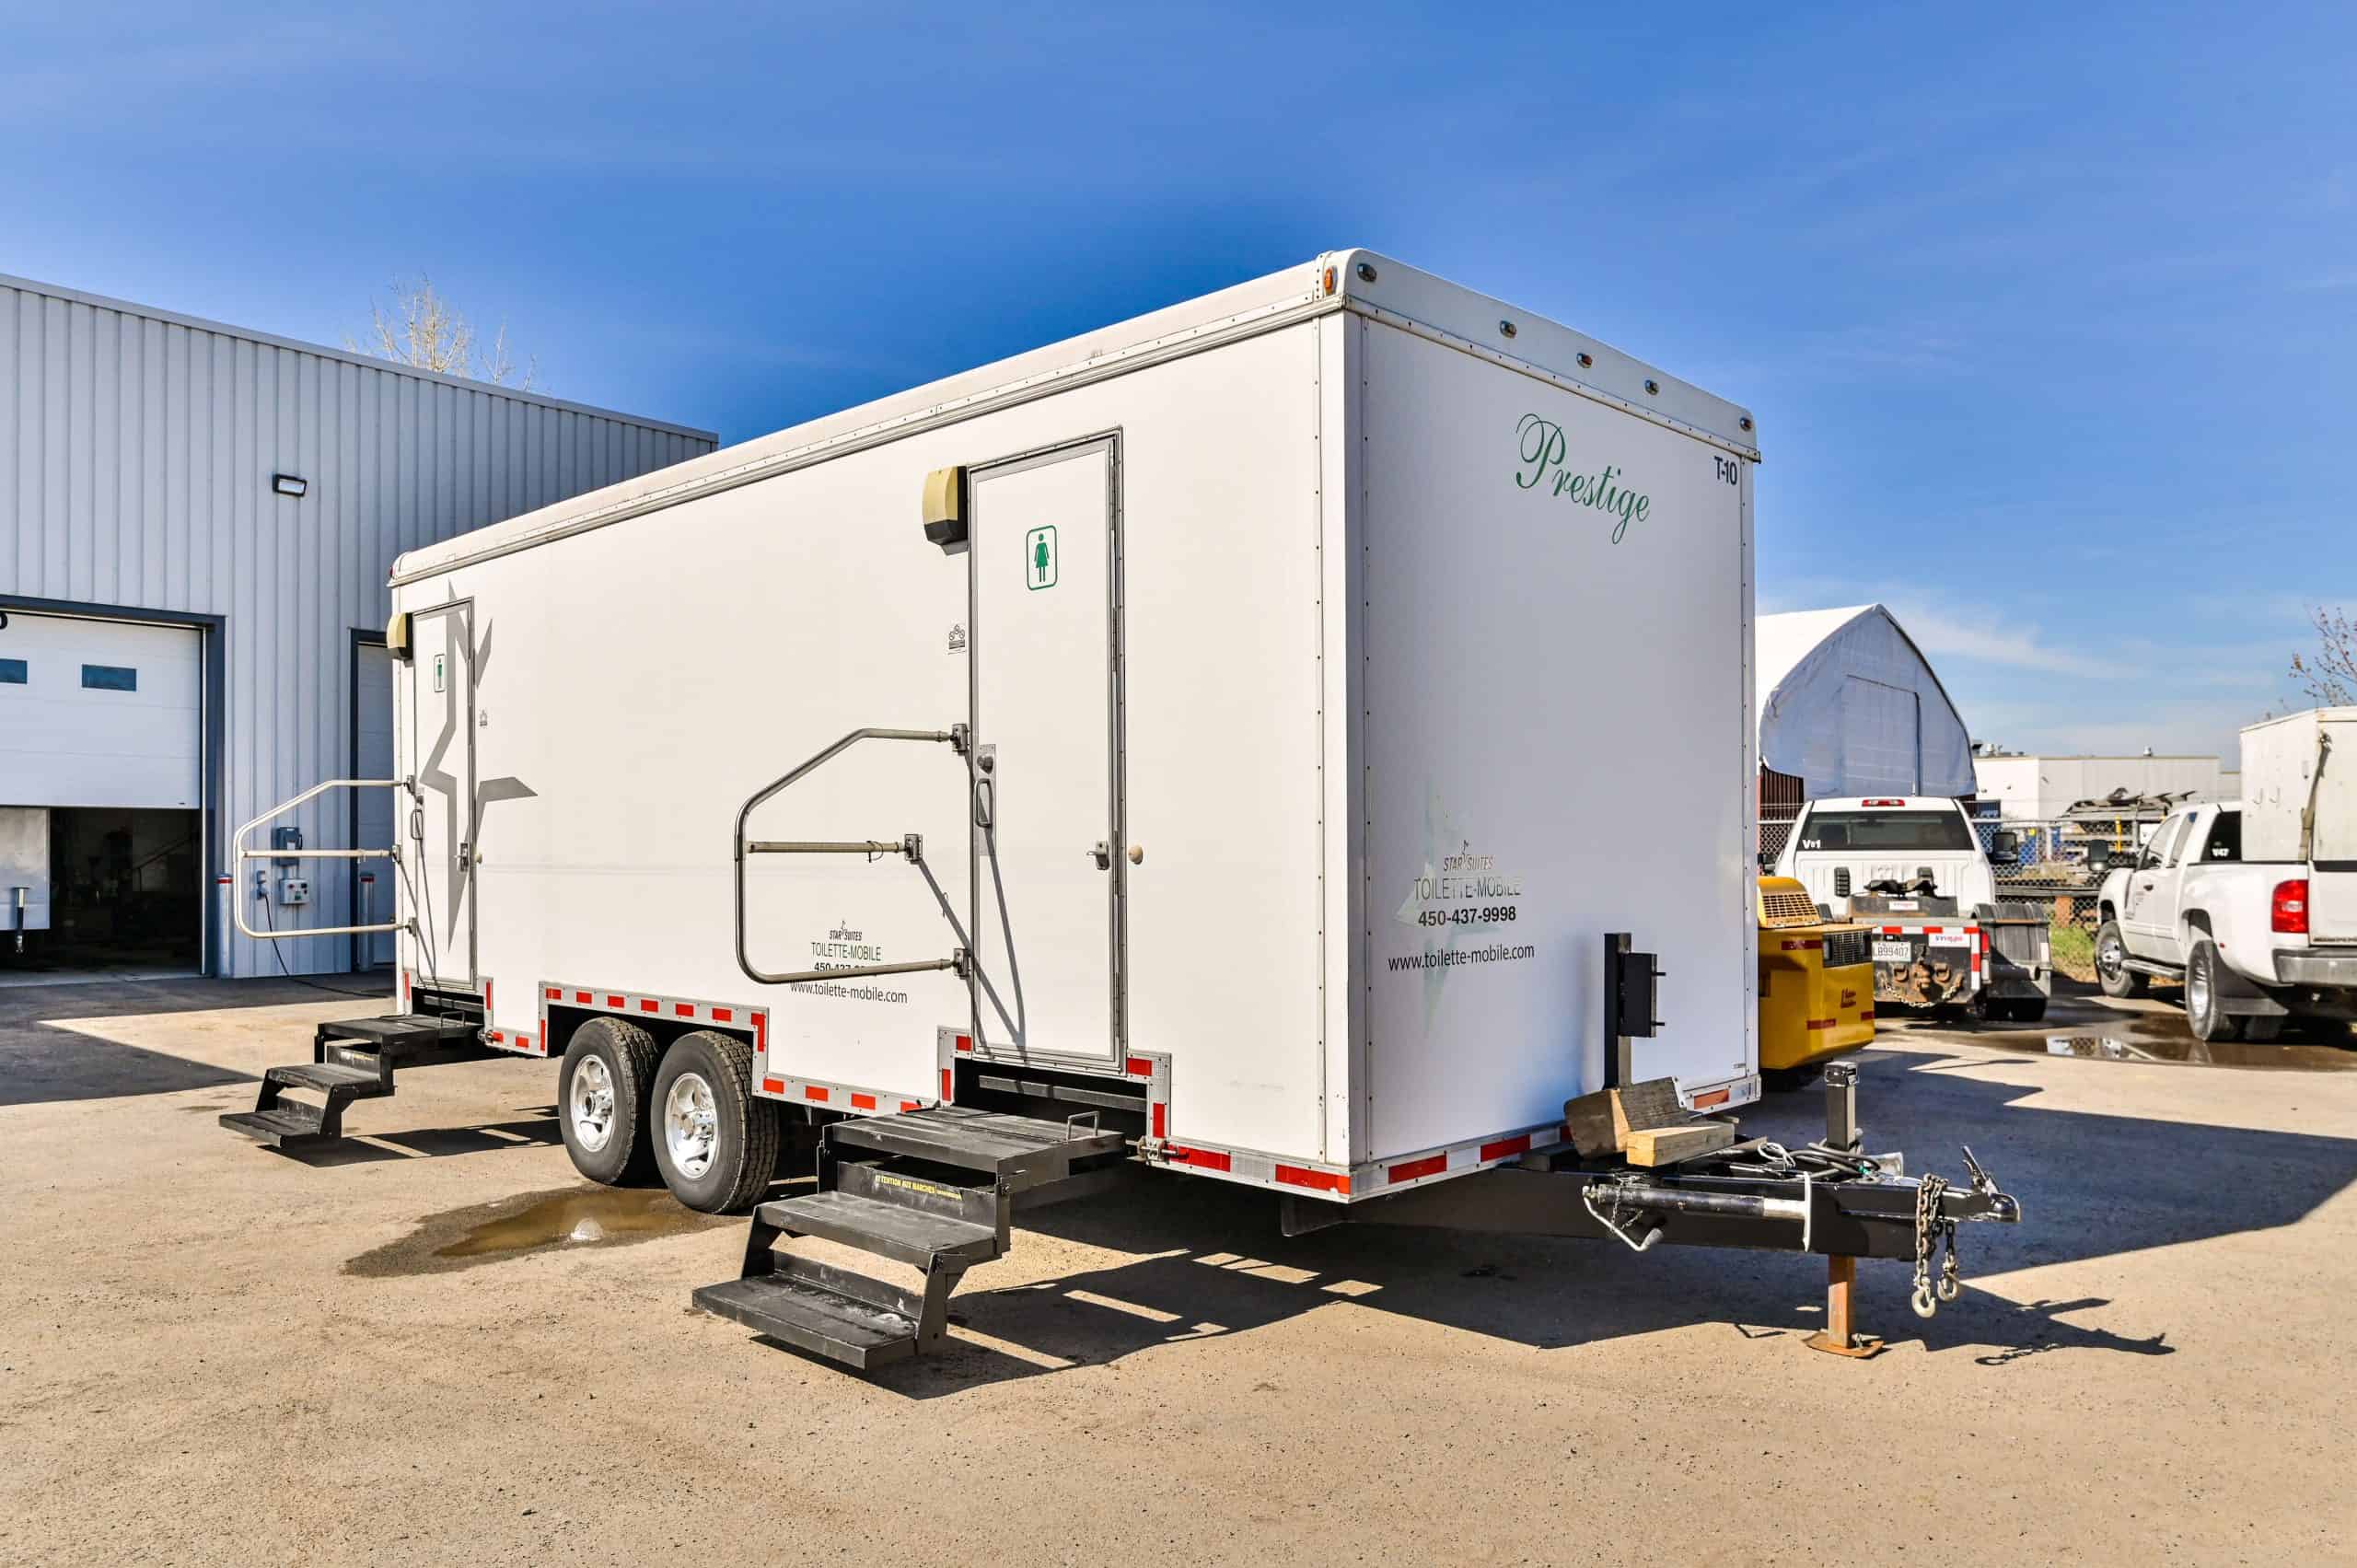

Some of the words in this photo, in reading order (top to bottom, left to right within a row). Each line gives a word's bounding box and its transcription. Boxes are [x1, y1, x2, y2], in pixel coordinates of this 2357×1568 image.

[1515, 412, 1650, 545] Prestige
[1713, 455, 1738, 486] T-10
[1443, 856, 1463, 872] STAR
[1467, 855, 1493, 870] SUITES
[1413, 877, 1523, 900] TOILETTE-MOBILE
[1418, 905, 1516, 927] 450-437-9998
[830, 930, 842, 940] STAR
[844, 930, 863, 941] SUITES
[811, 942, 881, 961] TOILETTE-MOBILE
[1388, 943, 1535, 971] www.toilette-mobile.com
[790, 981, 908, 1004] www.toilette-mobile.com
